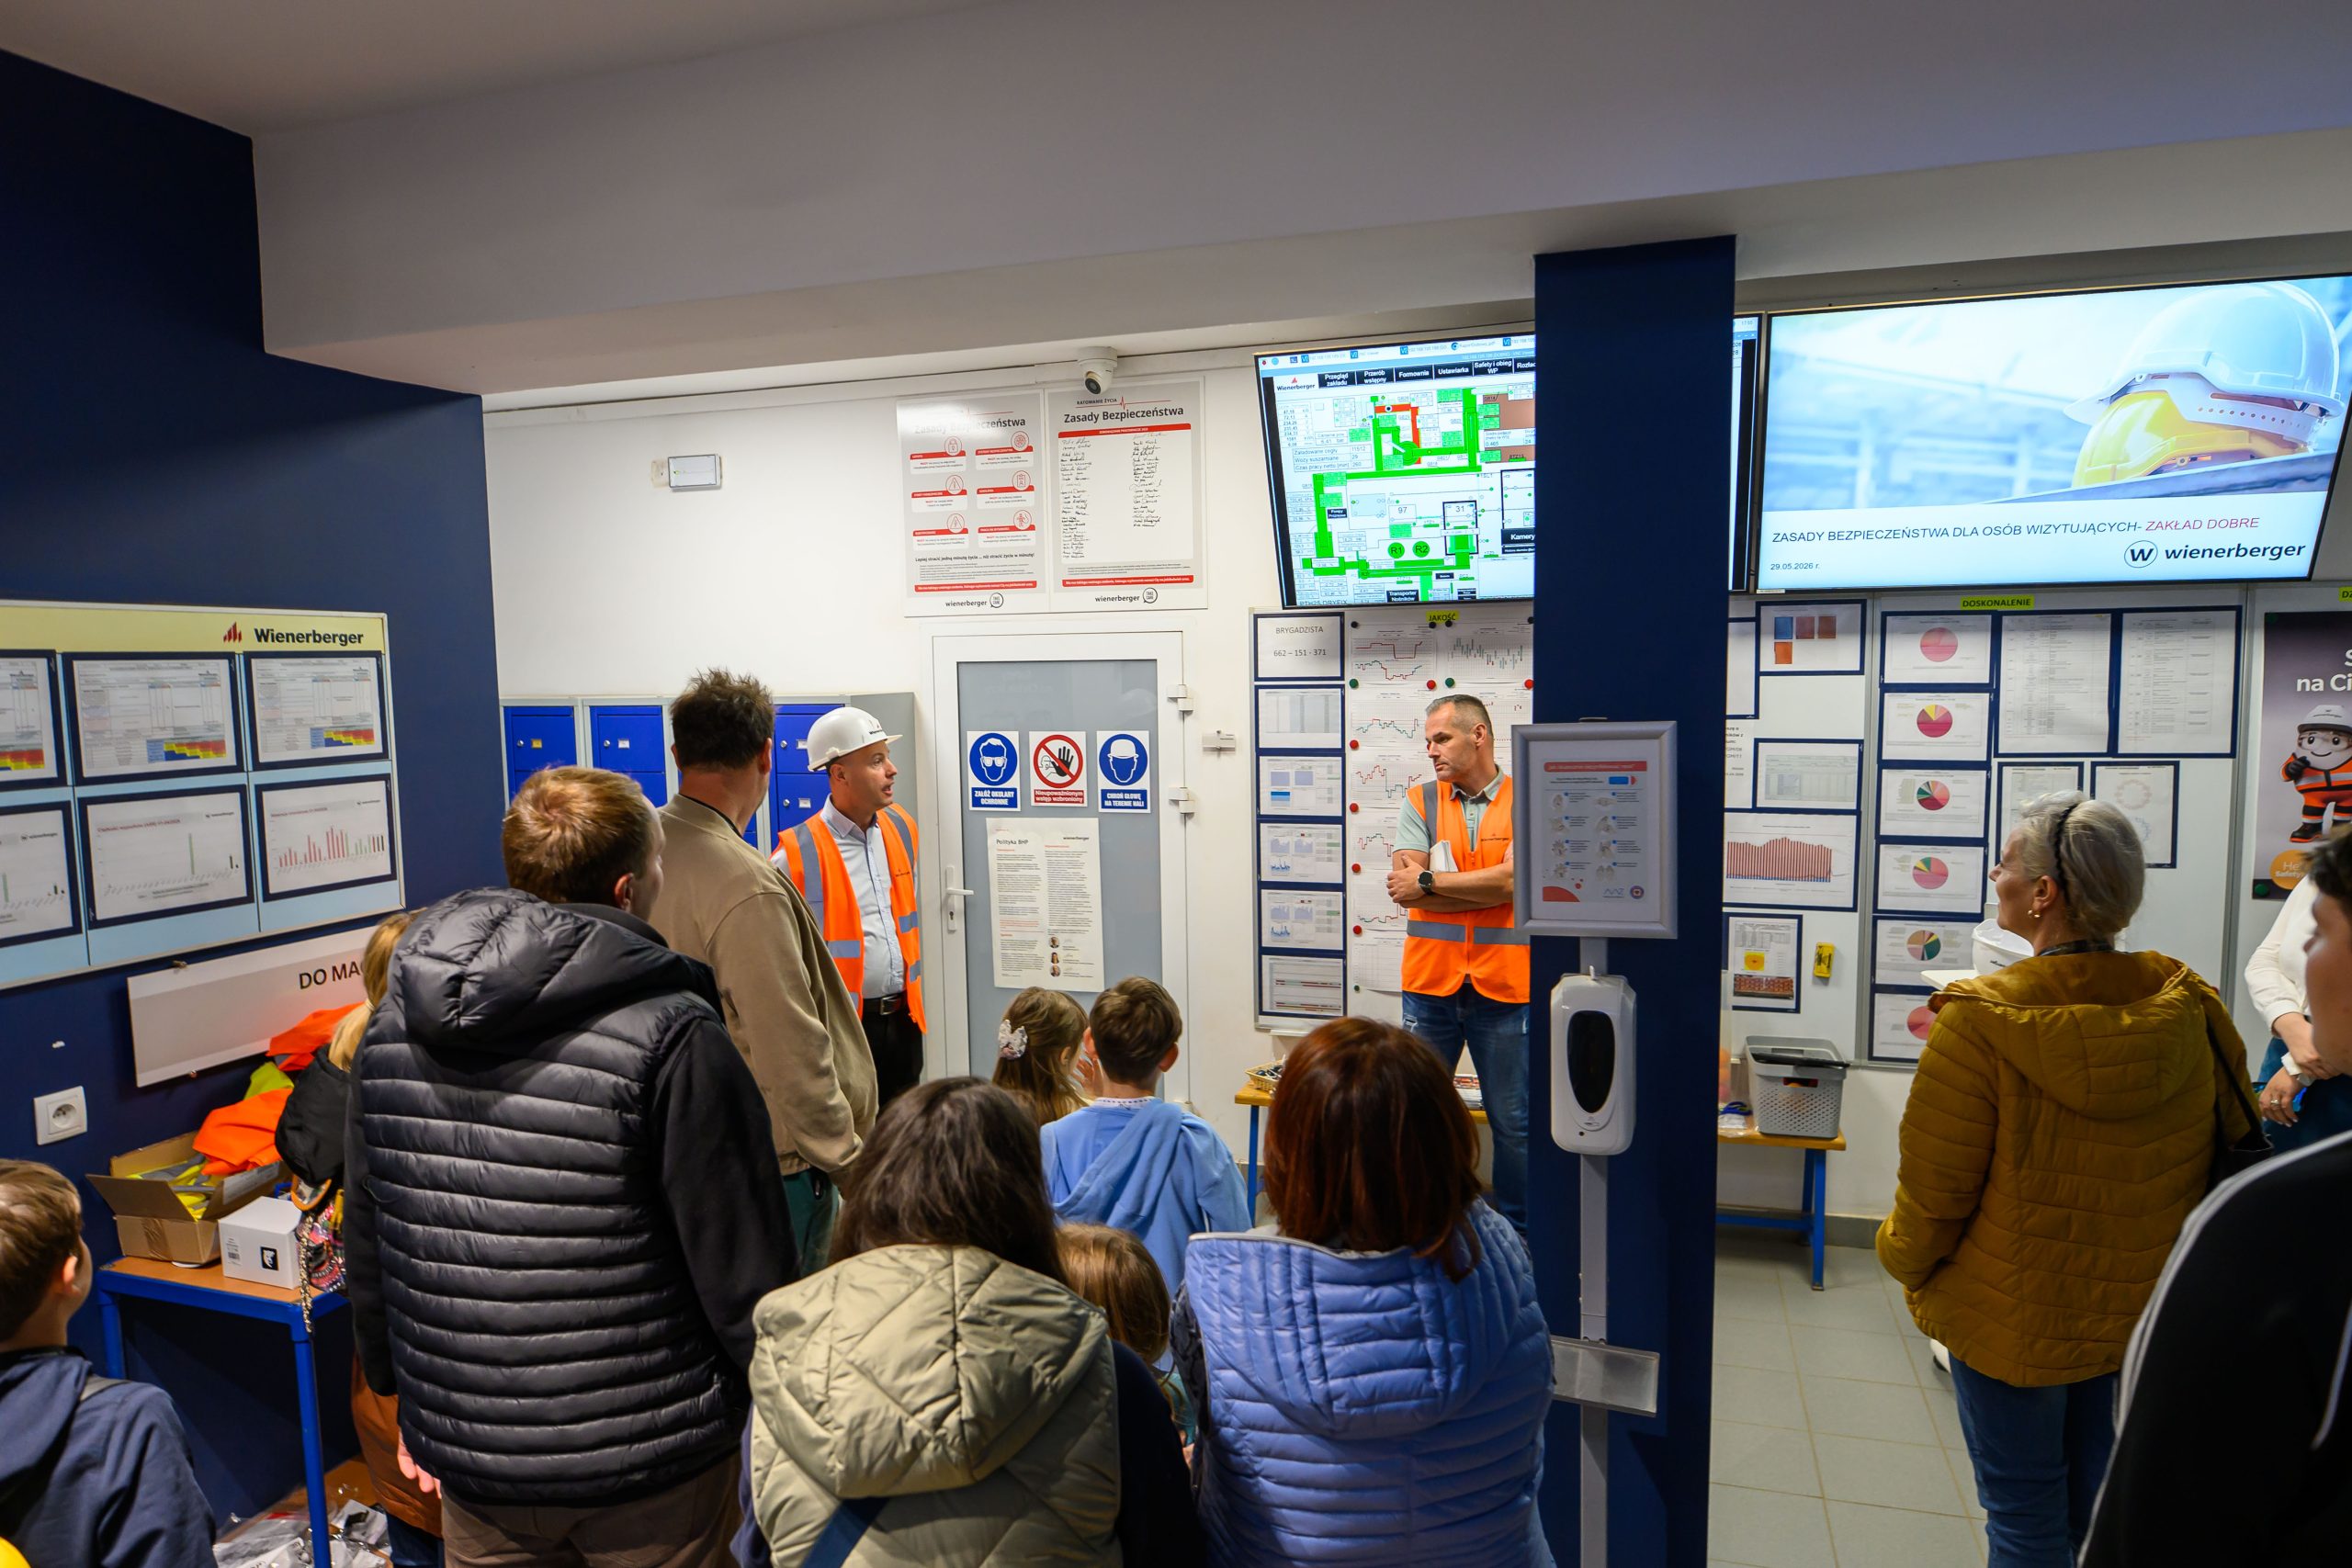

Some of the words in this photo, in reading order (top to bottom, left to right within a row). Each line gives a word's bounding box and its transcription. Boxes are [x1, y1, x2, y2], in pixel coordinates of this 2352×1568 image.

[1398, 369, 1430, 378] Formownia
[1438, 367, 1469, 375] Ustawiarka
[1324, 372, 1349, 380] Przegląd
[1276, 382, 1316, 391] Wienerberger
[1064, 412, 1099, 423] Zasady
[1102, 406, 1184, 423] Bezpieczeństwa
[1772, 531, 1825, 543] ZASADY
[1827, 525, 1950, 542] BEZPIECZEŃSTWA
[1952, 526, 1979, 537] DLA
[1982, 523, 2022, 536] OSÓB
[2026, 521, 2143, 536] WIZYTUJĄCYCH-
[2145, 518, 2203, 532] ZAKŁAD
[2207, 517, 2260, 530] DOBRE
[1510, 533, 1535, 541] Kamery
[2165, 542, 2307, 561] wienerberger
[1770, 562, 1814, 570] 29.05.2026
[1815, 562, 1820, 570] r.
[945, 599, 988, 607] wienerberger
[1094, 594, 1140, 603] wienerberger
[1962, 598, 2031, 607] DOSKONALENIE
[1429, 612, 1456, 622] JAKOŚĆ
[1275, 626, 1324, 634] BRYGADZISTA
[254, 627, 364, 647] Wienerberger
[1295, 649, 1307, 657] 151
[2296, 678, 2324, 692] na
[974, 789, 990, 798] ZAŁÓŻ
[991, 790, 1015, 798] OKULARY
[2282, 861, 2303, 871] He
[299, 968, 327, 989] DO
[332, 961, 367, 982] MA
